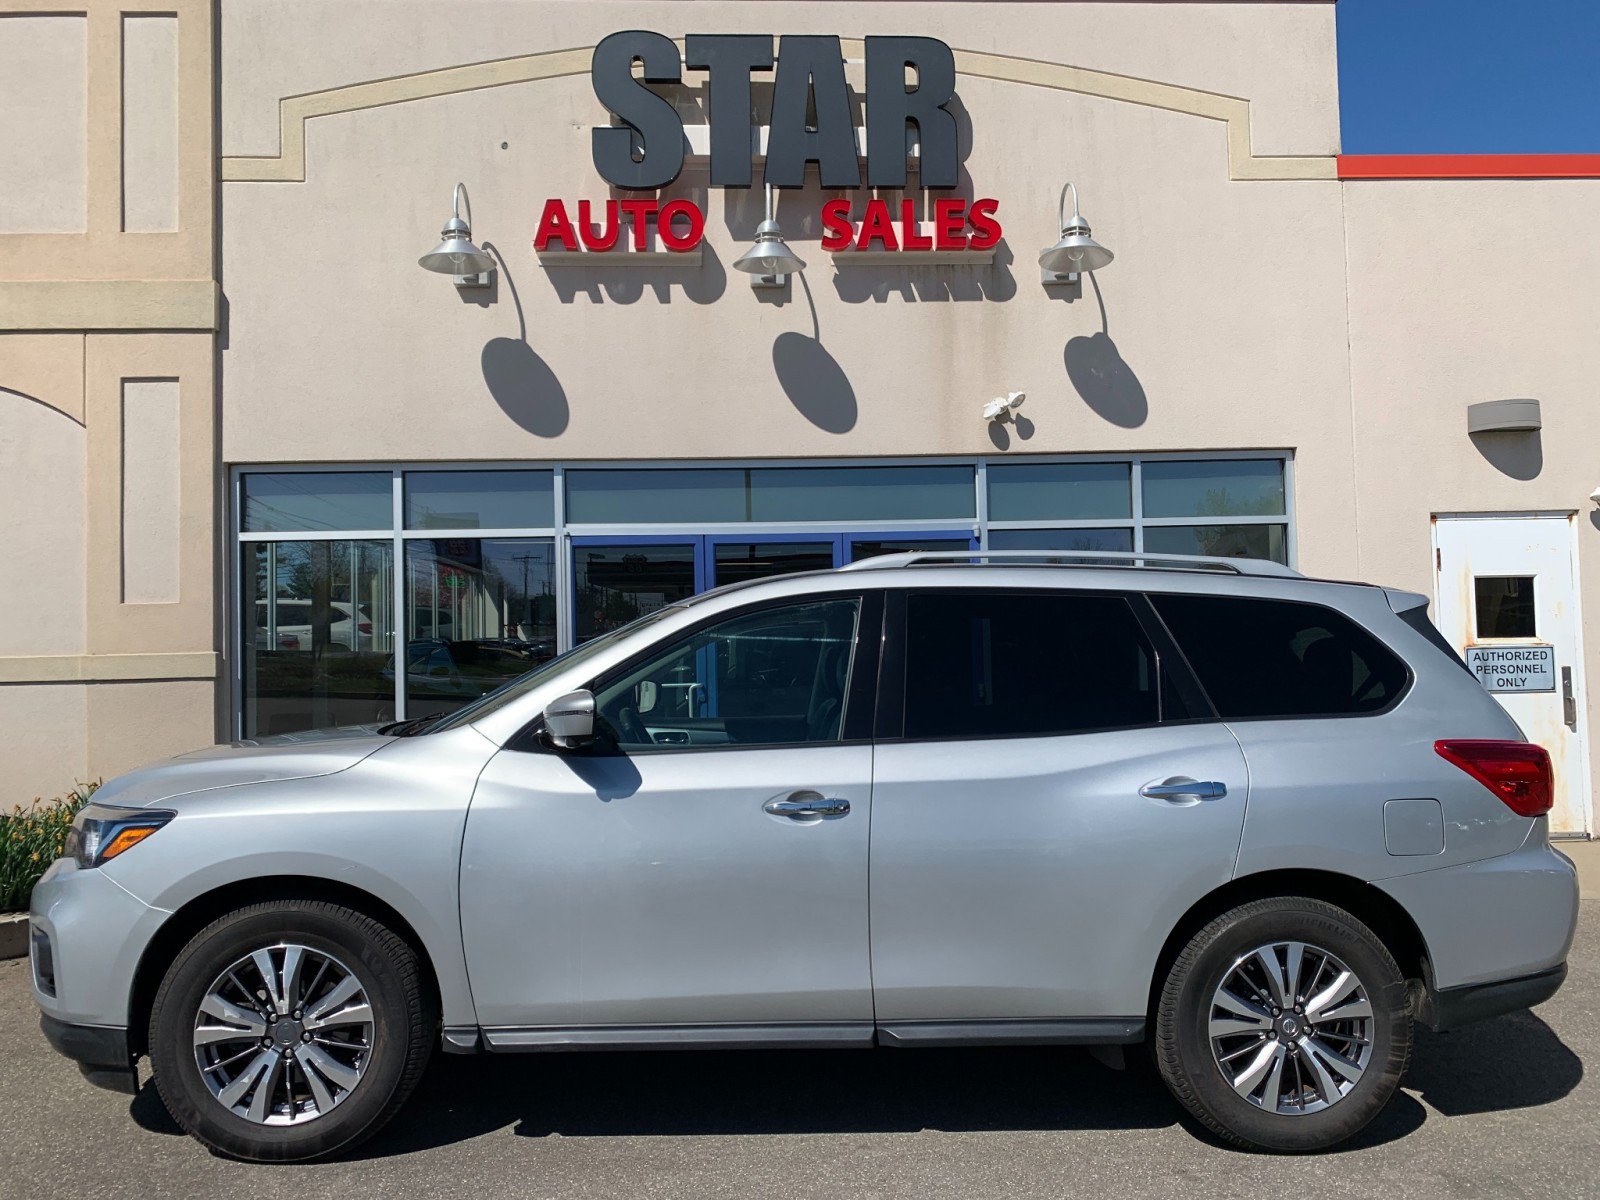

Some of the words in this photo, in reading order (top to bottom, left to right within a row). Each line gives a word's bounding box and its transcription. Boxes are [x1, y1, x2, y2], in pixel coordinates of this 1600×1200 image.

[592, 30, 958, 189] STAR
[533, 199, 704, 253] AUTO
[821, 198, 1002, 252] SALES
[1473, 651, 1548, 662] AUTHORIZED
[1476, 664, 1547, 675] PERSONNEL
[1497, 678, 1527, 688] ONLY
